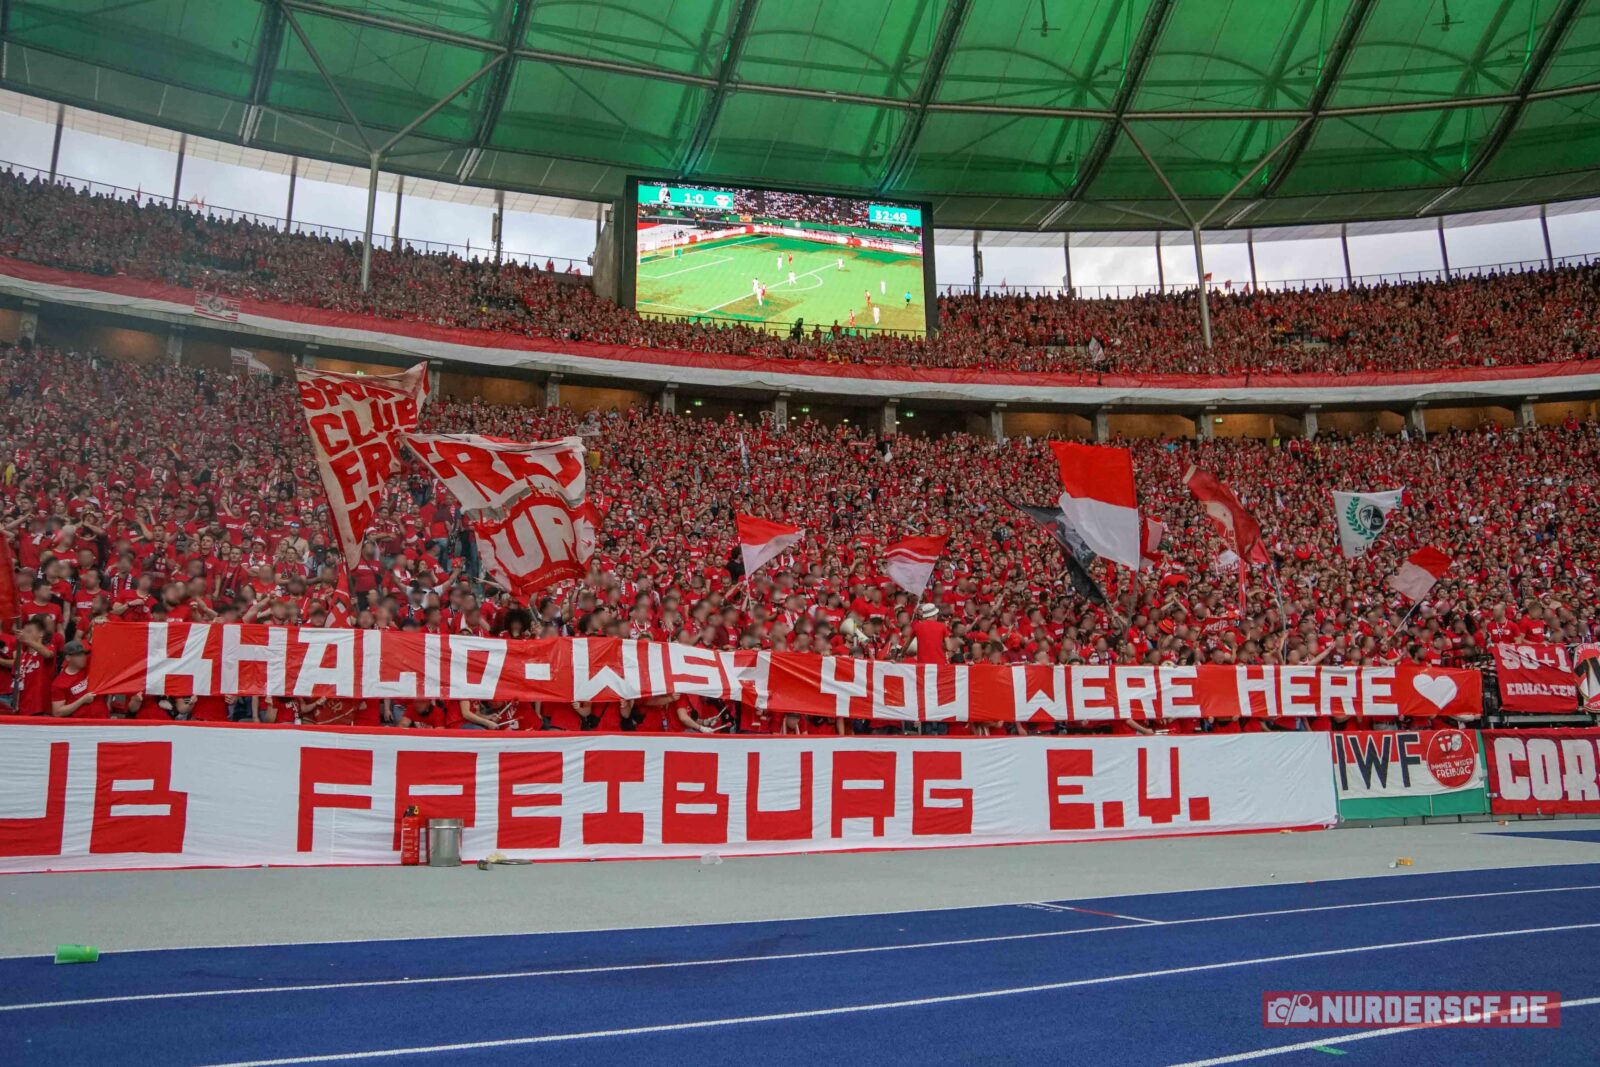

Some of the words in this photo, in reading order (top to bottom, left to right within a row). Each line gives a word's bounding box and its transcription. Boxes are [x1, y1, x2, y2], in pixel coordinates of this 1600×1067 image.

[684, 193, 704, 204] 1:0
[310, 397, 418, 457] CLUB
[146, 622, 508, 699] KHALID
[572, 638, 771, 708] WISH
[820, 656, 969, 722] YOU
[1012, 665, 1201, 721] WERE
[1236, 665, 1399, 717] HERE
[1506, 683, 1576, 697] ERHALTEN
[1334, 732, 1421, 791] IWF
[1436, 766, 1471, 778] FREIBURG
[1494, 737, 1600, 801] COR
